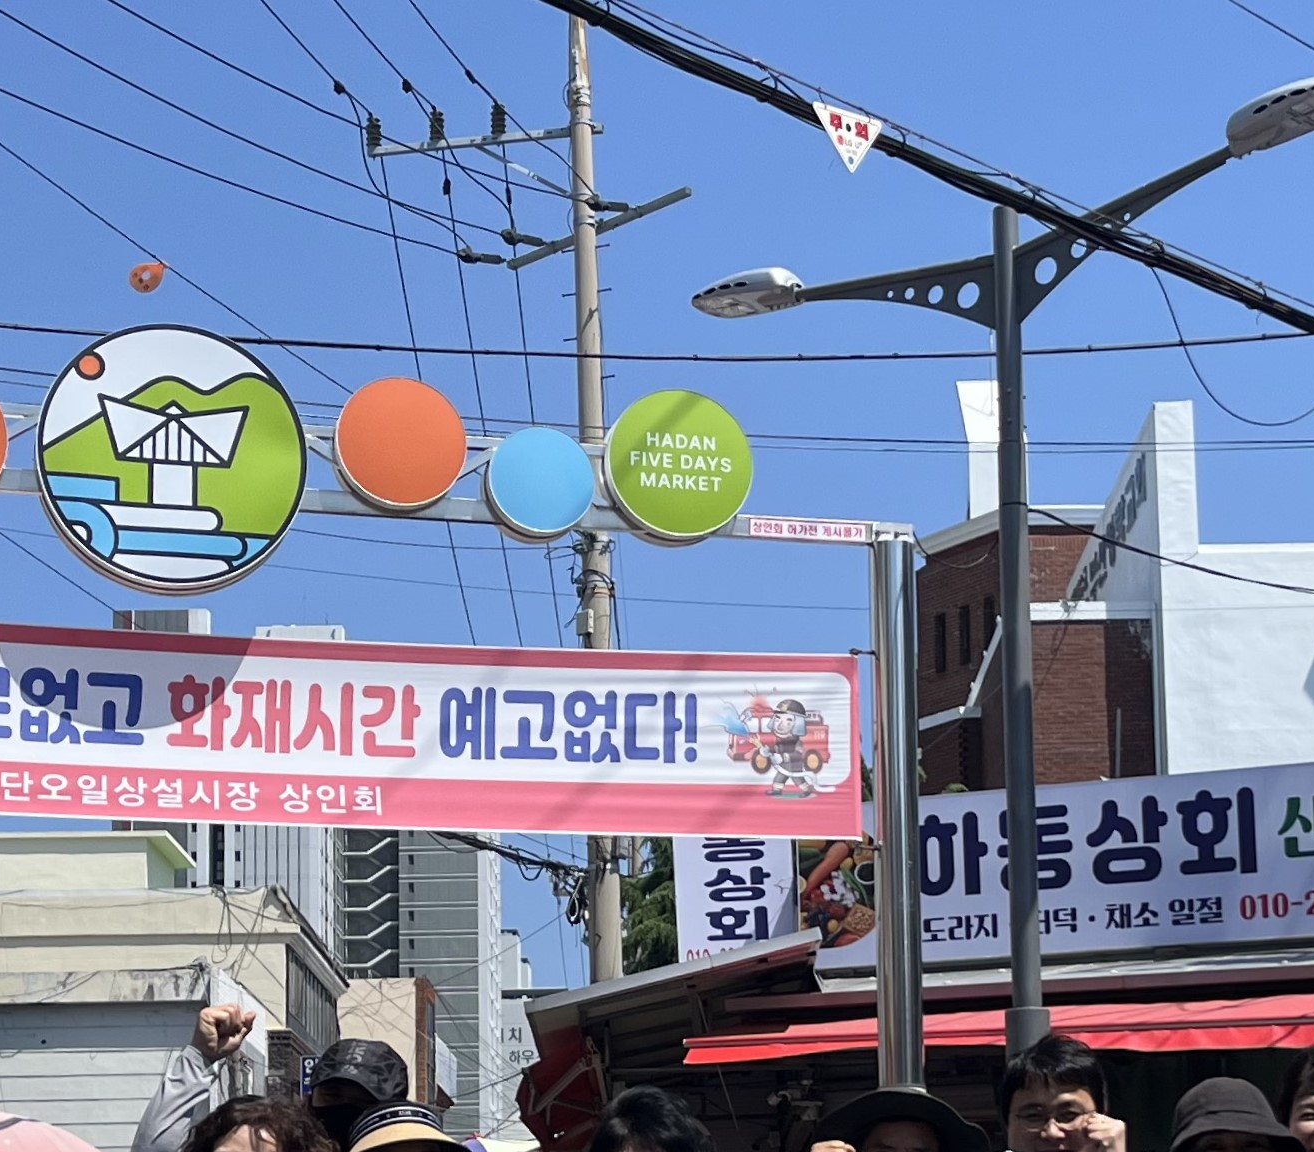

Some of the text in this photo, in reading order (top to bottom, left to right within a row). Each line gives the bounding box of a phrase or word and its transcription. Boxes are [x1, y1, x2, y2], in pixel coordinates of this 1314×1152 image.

[646, 431, 716, 451] HADAN
[630, 451, 732, 473] FIVE DAYS
[640, 472, 722, 492] MARKET
[166, 674, 420, 758] 화재시간
[439, 685, 699, 765] 예고없다!
[279, 783, 384, 817] 상인회
[919, 786, 1259, 897] 하동상회
[921, 913, 999, 943] 도라지
[1105, 903, 1161, 931] 채소
[1169, 896, 1225, 927] 일절
